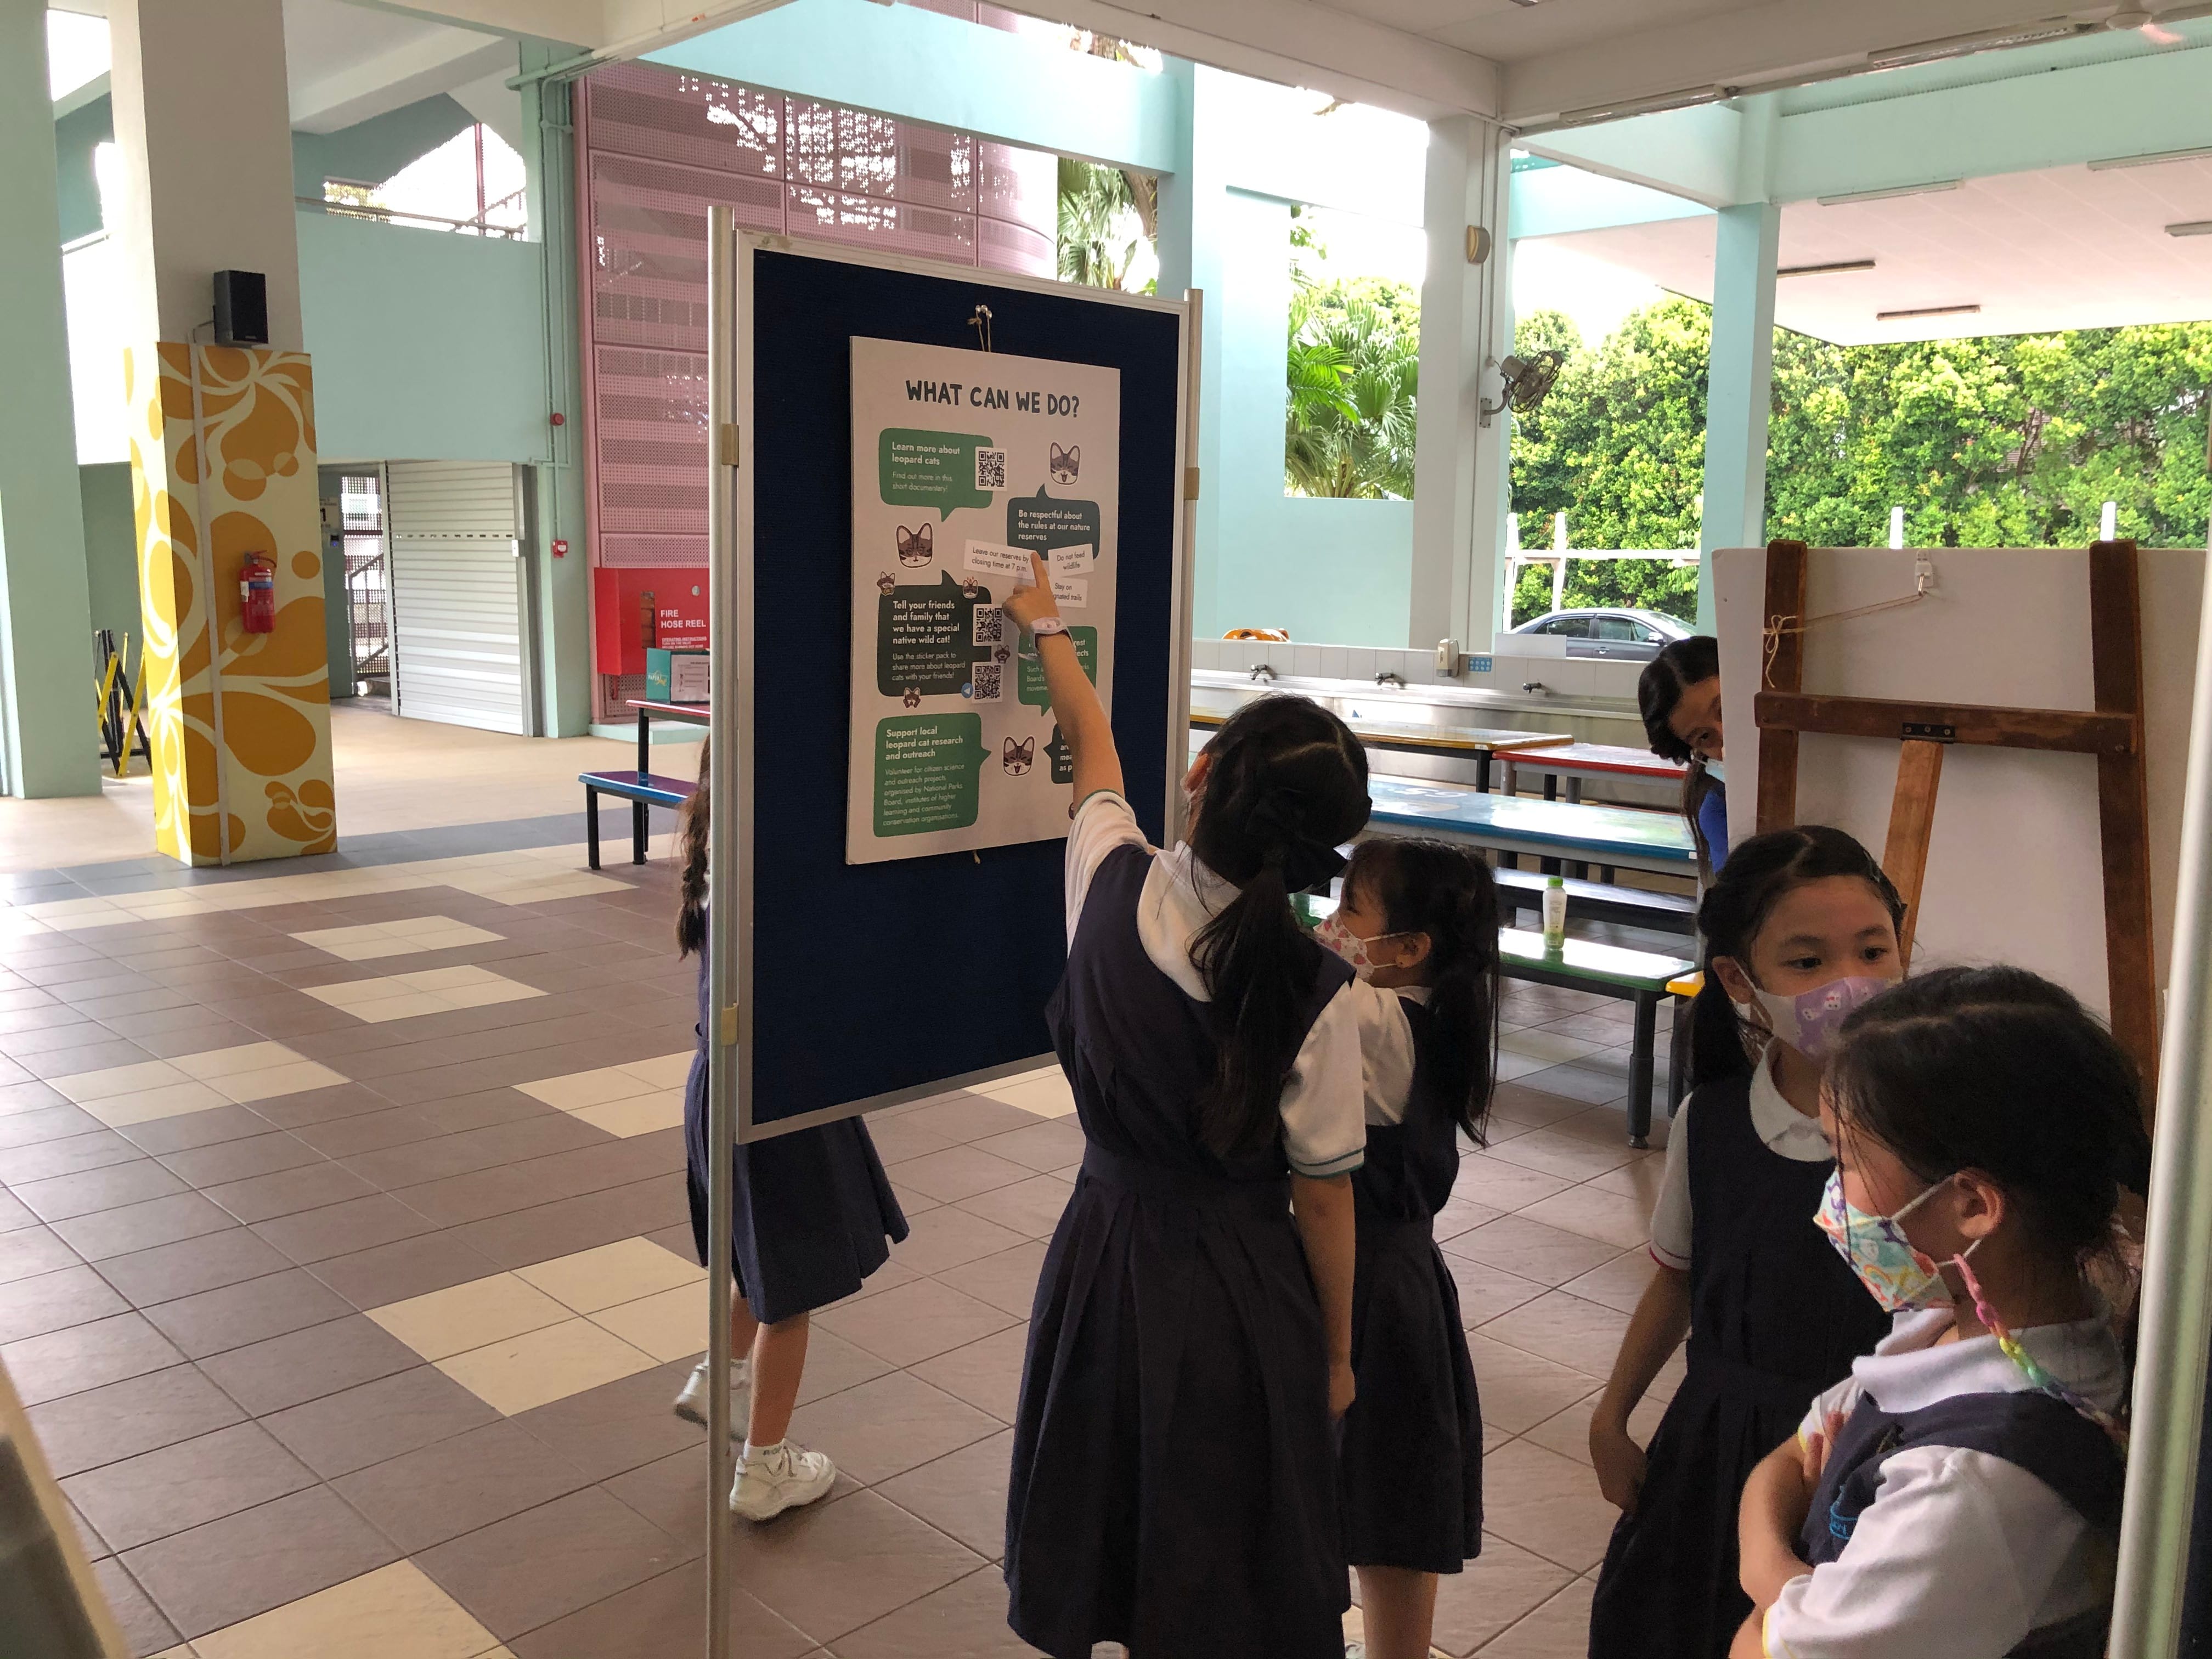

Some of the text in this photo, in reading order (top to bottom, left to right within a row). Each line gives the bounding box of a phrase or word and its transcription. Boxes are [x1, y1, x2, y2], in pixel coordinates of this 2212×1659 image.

[906, 380, 1080, 417] WHAT CAN WE DO?
[892, 441, 914, 451] Learn
[939, 445, 960, 455] about
[892, 453, 940, 465] leopard cats
[893, 471, 906, 479] Find
[942, 473, 953, 482] this
[909, 483, 948, 493] documentary!
[1018, 509, 1082, 520] Be respectful about
[1018, 520, 1029, 528] the
[973, 546, 988, 556] Leave
[1000, 552, 1022, 561] reserves
[1023, 554, 1029, 563] by
[1074, 550, 1085, 558] feed
[972, 556, 991, 568] closing
[992, 560, 1004, 568] time
[1063, 561, 1080, 570] wildlife
[1054, 582, 1064, 591] Stay
[893, 600, 955, 611] Tell your friends
[661, 610, 679, 618] FIRE
[893, 611, 950, 623] and family that
[661, 620, 683, 628] HOSE
[906, 624, 924, 632] have
[934, 623, 960, 634] special
[893, 635, 916, 644] native
[918, 635, 934, 644] wild
[944, 662, 966, 671] leopard
[887, 726, 938, 738] Support local
[886, 738, 916, 749] leopard
[932, 736, 963, 746] research
[885, 749, 935, 760] and outreach
[884, 775, 946, 786] and outreach projects
[884, 788, 913, 797] organised
[924, 783, 947, 792] National
[949, 782, 963, 790] Parks
[938, 793, 956, 802] higher
[883, 808, 907, 816] learning
[922, 803, 952, 812] community
[883, 817, 919, 826] conservation
